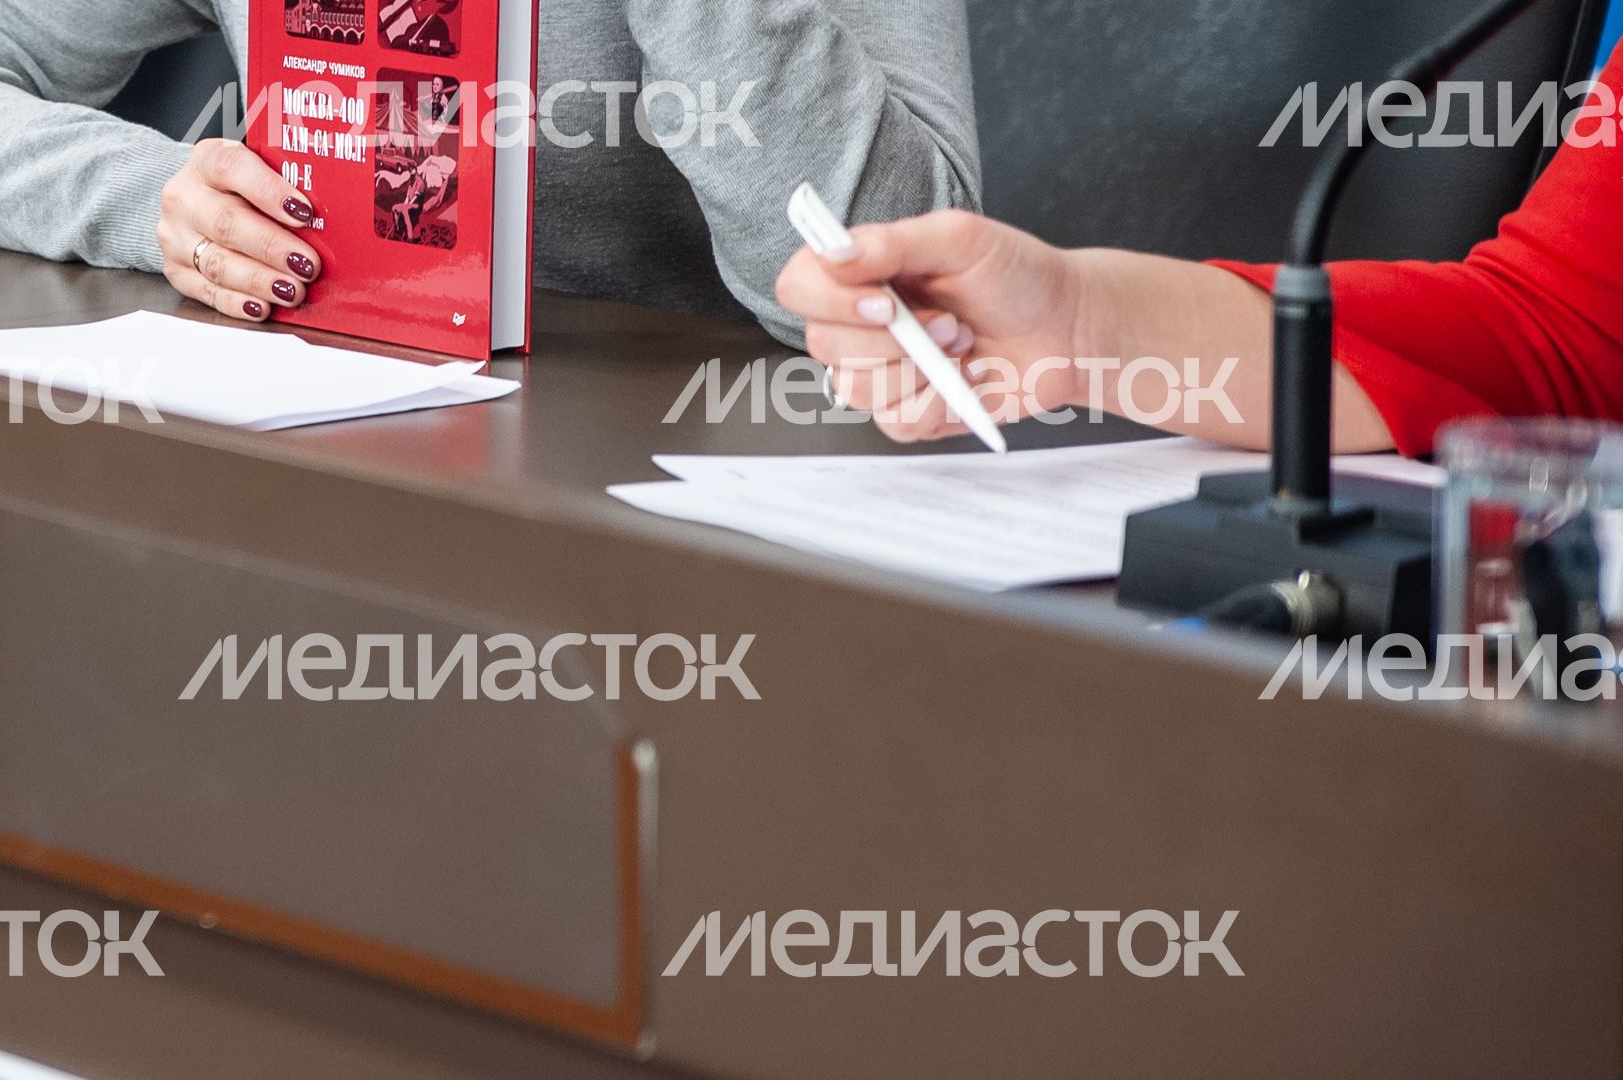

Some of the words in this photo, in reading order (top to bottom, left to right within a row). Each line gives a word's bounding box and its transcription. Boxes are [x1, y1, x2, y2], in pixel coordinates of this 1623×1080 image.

[283, 55, 327, 75] АЛЕКСАНДР
[329, 62, 366, 79] ЧУМИКОВ
[282, 87, 365, 126] МОСКВА-400
[282, 124, 367, 163] КАМ-СА-МОЛ!
